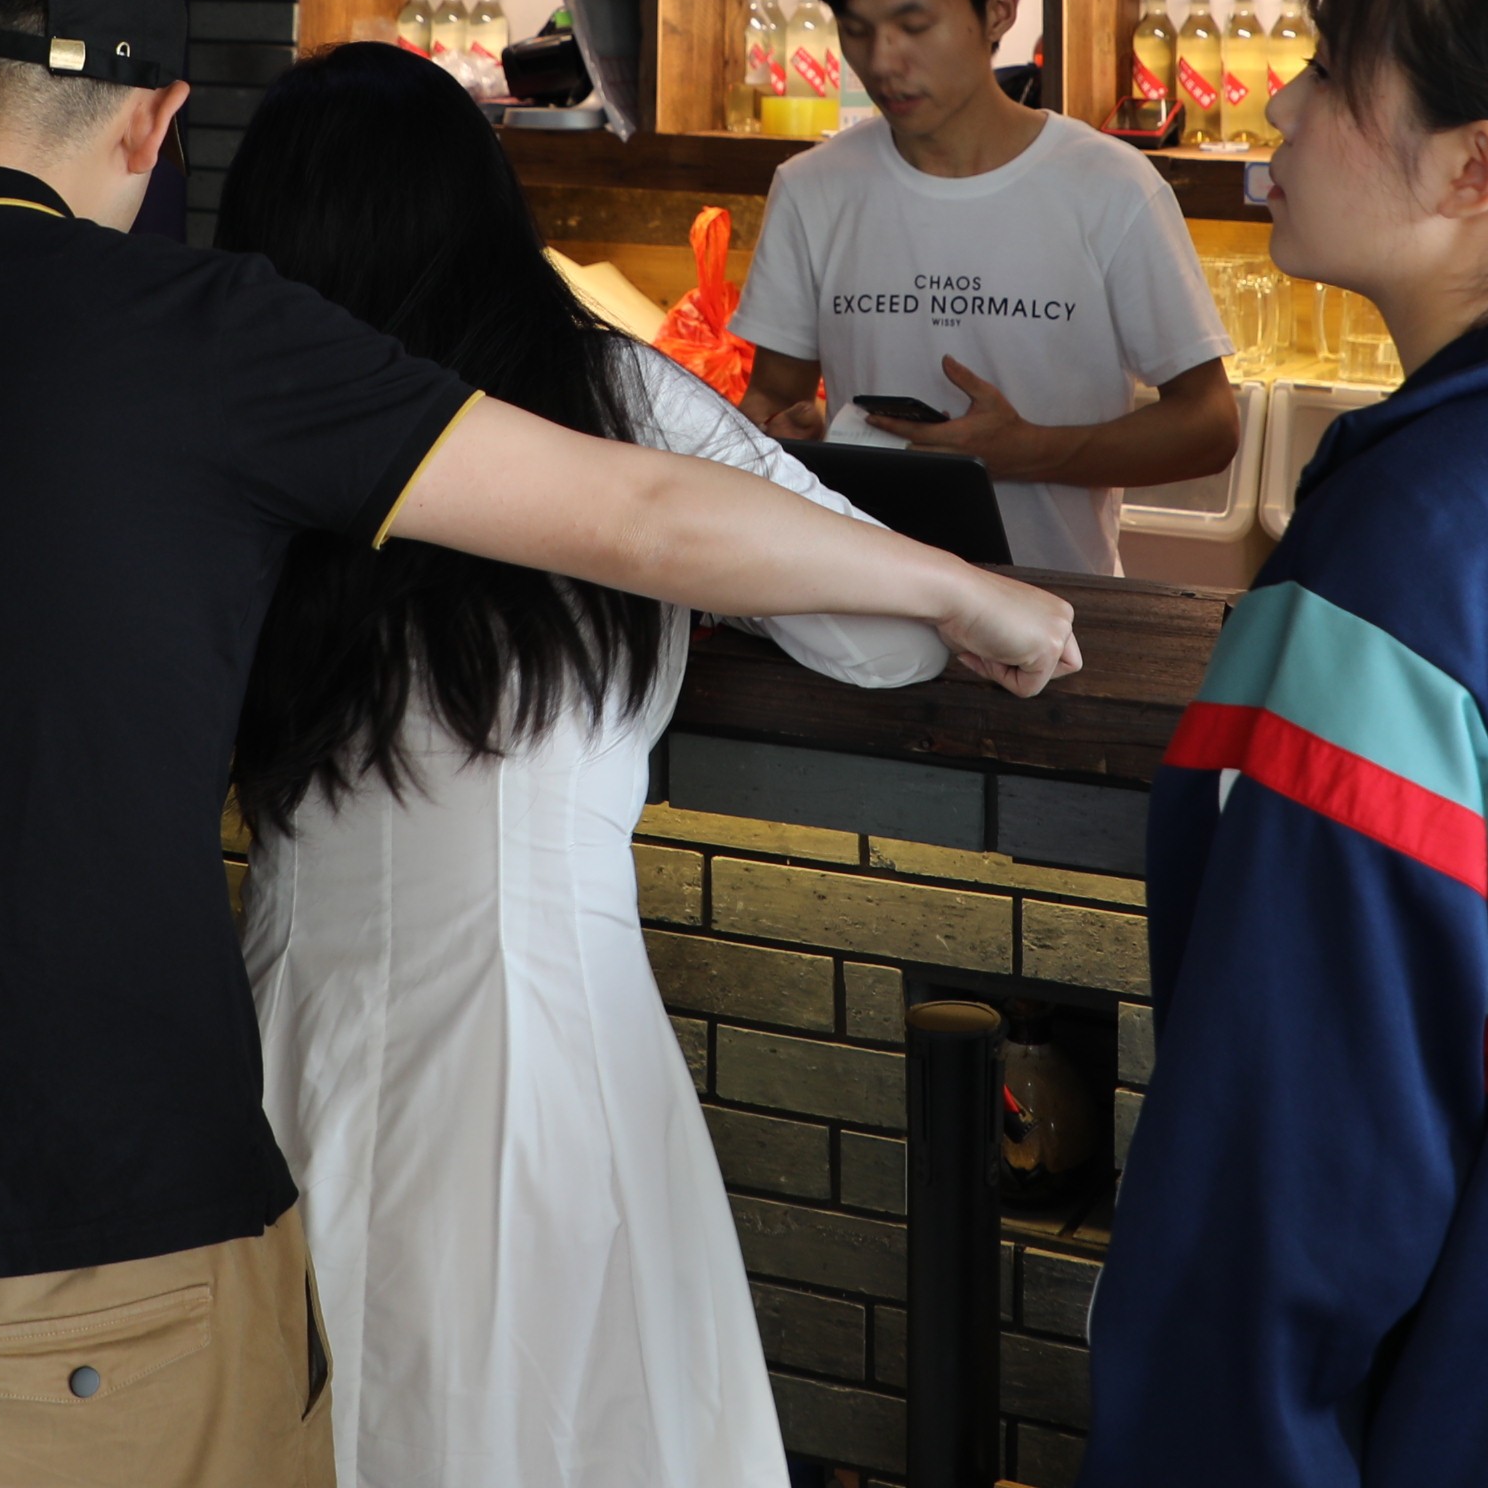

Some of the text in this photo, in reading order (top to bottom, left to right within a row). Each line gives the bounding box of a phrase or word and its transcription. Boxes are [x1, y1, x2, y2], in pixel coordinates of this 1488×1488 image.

[914, 274, 982, 292] CHAOS
[833, 294, 1077, 322] EXCEED NORMALCY
